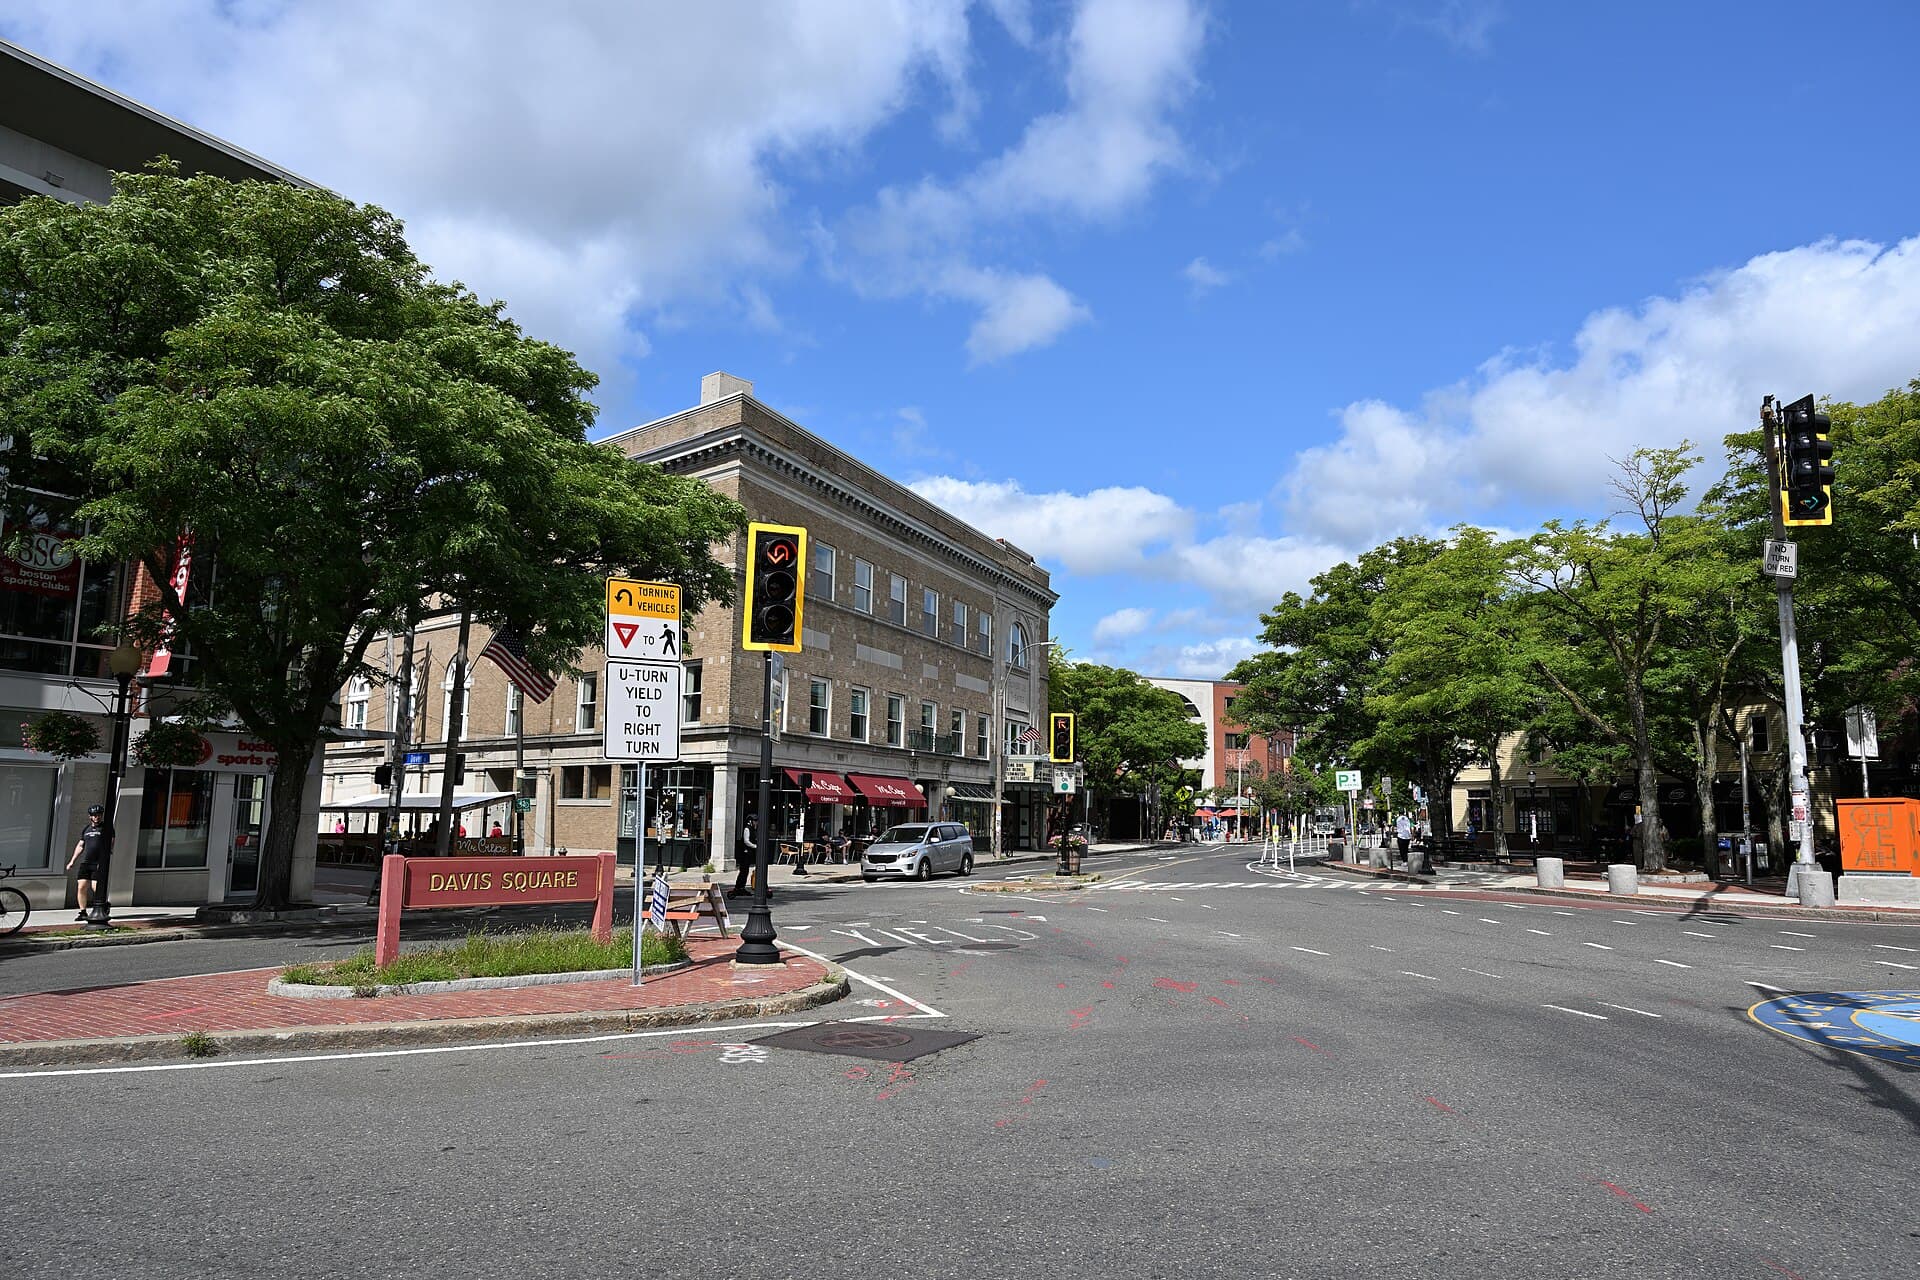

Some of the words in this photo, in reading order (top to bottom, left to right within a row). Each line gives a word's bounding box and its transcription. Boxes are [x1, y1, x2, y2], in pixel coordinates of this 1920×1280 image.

[1774, 544, 1787, 553] NO
[1771, 554, 1790, 563] TURN
[19, 568, 57, 581] boston
[1767, 563, 1778, 571] ON
[1780, 565, 1794, 573] RED
[3, 576, 39, 588] sports
[41, 581, 71, 592] clubs
[638, 586, 675, 599] TURNING
[637, 601, 676, 614] VEHICLES
[643, 635, 655, 645] TO
[619, 668, 668, 683] U-TURN
[625, 686, 662, 700] YIELD
[635, 704, 651, 717] TO
[624, 722, 662, 736] RIGHT
[238, 740, 279, 752] bosto
[625, 740, 660, 754] TURN
[217, 754, 263, 766] sports
[1850, 806, 1893, 829] OH
[1854, 825, 1896, 847] YE
[429, 872, 493, 892] DAVIS
[501, 870, 578, 892] SQUARE
